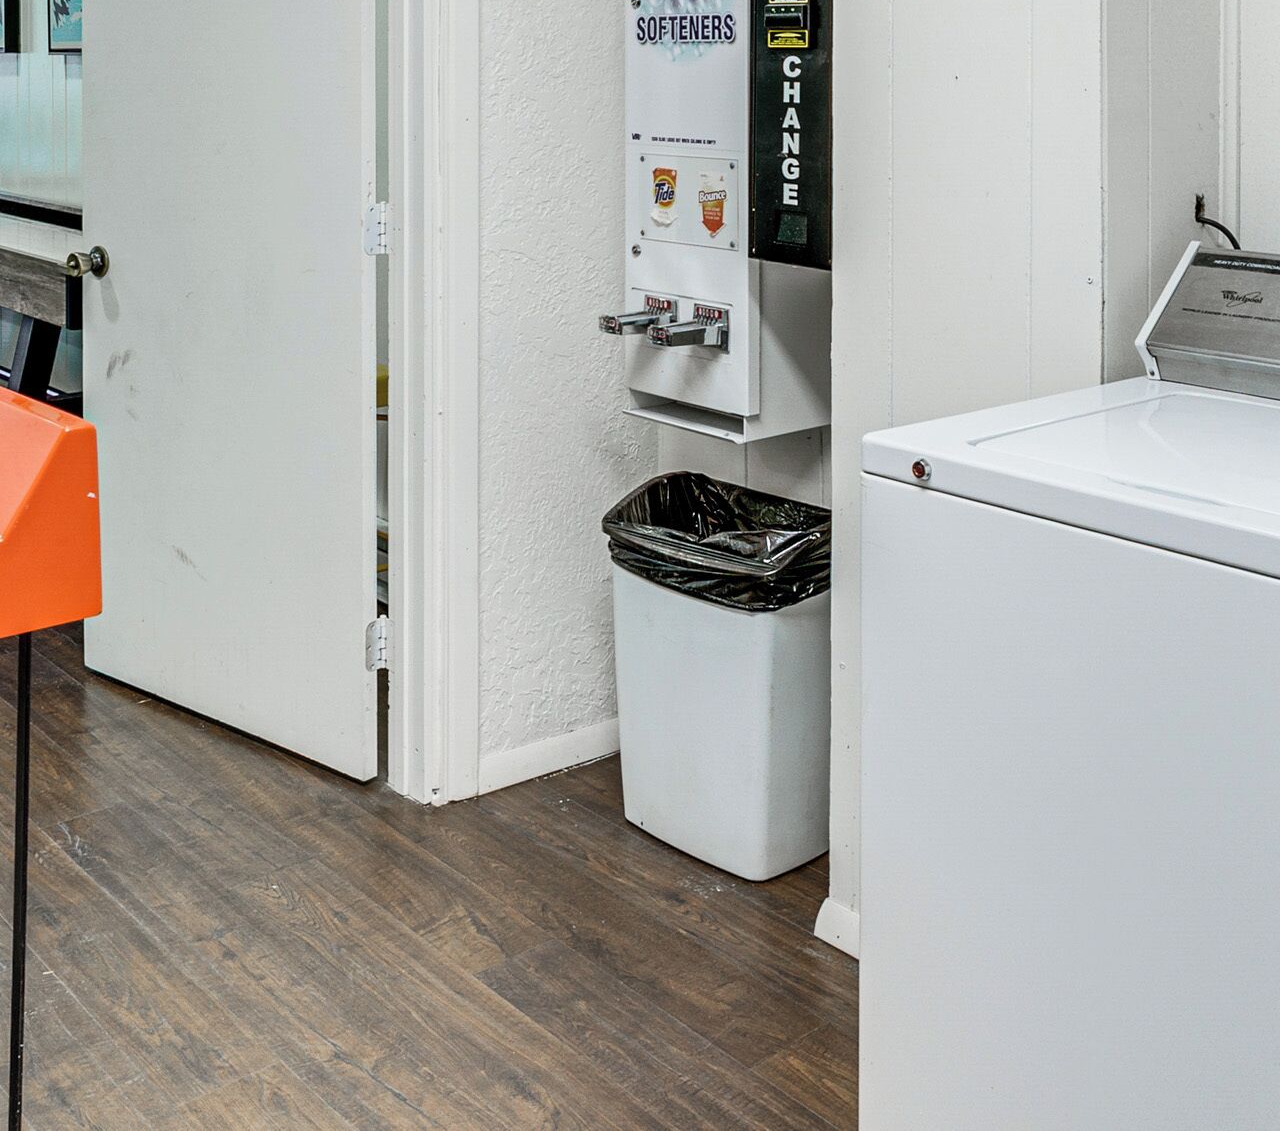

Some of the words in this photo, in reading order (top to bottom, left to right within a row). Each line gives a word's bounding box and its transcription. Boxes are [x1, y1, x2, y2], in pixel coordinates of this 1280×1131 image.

[636, 12, 736, 44] SOFTENERS
[781, 55, 803, 207] CHANGE
[654, 182, 675, 204] Tide
[698, 189, 727, 204] Bounce
[1221, 290, 1264, 306] Whirlpool
